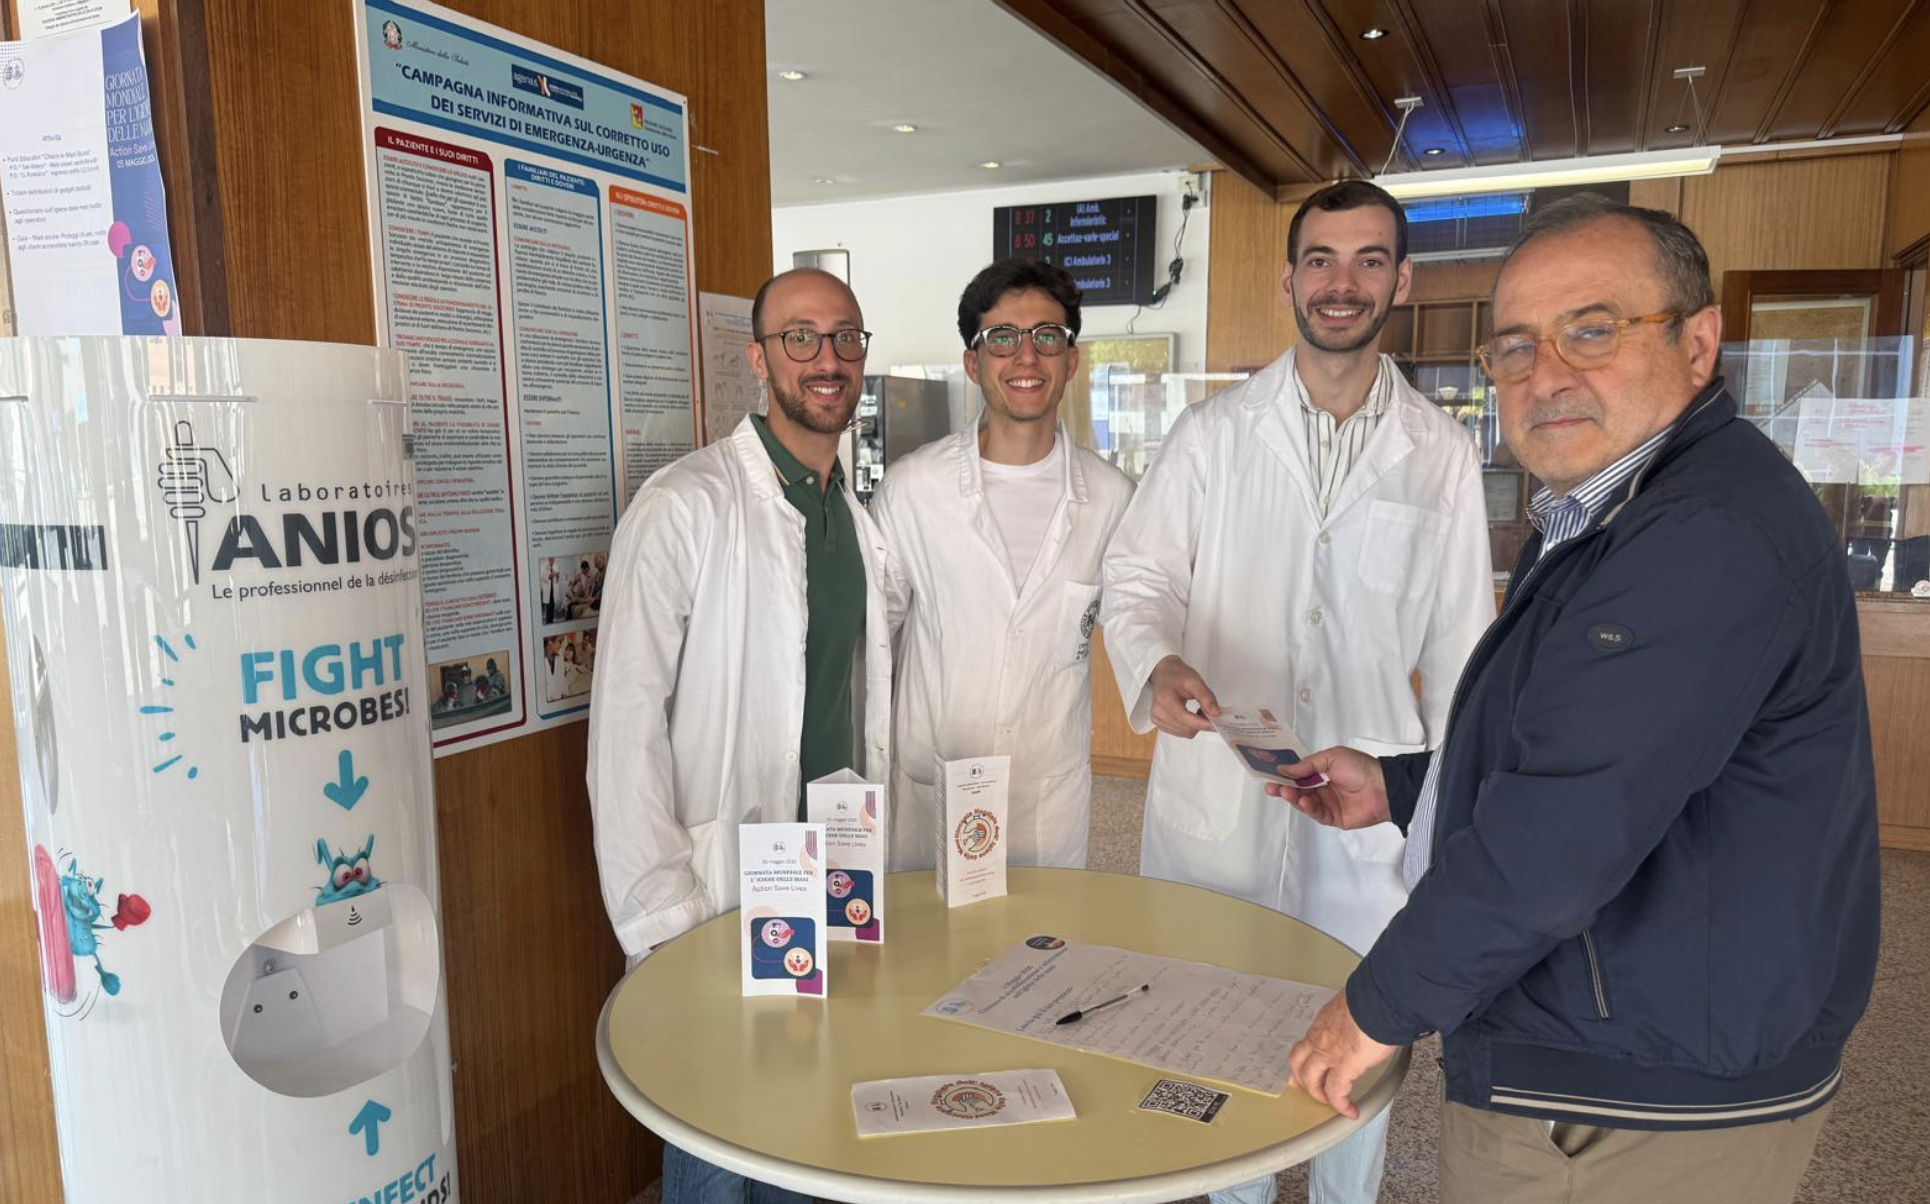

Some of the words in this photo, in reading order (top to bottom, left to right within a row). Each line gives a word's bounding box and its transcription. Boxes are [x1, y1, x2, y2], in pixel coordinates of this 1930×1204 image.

[107, 108, 126, 126] PER
[431, 94, 454, 115] DEI
[457, 103, 506, 129] SERVIZI
[509, 118, 522, 133] DI
[487, 90, 572, 128] INFORMATIVA
[574, 117, 594, 135] SUL
[595, 125, 649, 151] CORRETTO
[651, 142, 671, 159] USO
[108, 123, 140, 143] DELLE
[387, 136, 395, 145] IL
[395, 137, 430, 153] PAZIENTE
[439, 148, 455, 159] SUOI
[456, 152, 479, 165] DIRITTI
[549, 170, 560, 179] DEL
[1044, 208, 1052, 224] 2
[1074, 278, 1106, 290] mbulatorio
[212, 505, 416, 571] ANIOS
[212, 584, 233, 600] Le
[239, 576, 343, 601] professionnel
[347, 575, 363, 589] de
[365, 573, 375, 587] la
[240, 633, 405, 705] FIGHT
[239, 687, 410, 744] MICROBES!
[773, 884, 790, 892] Save
